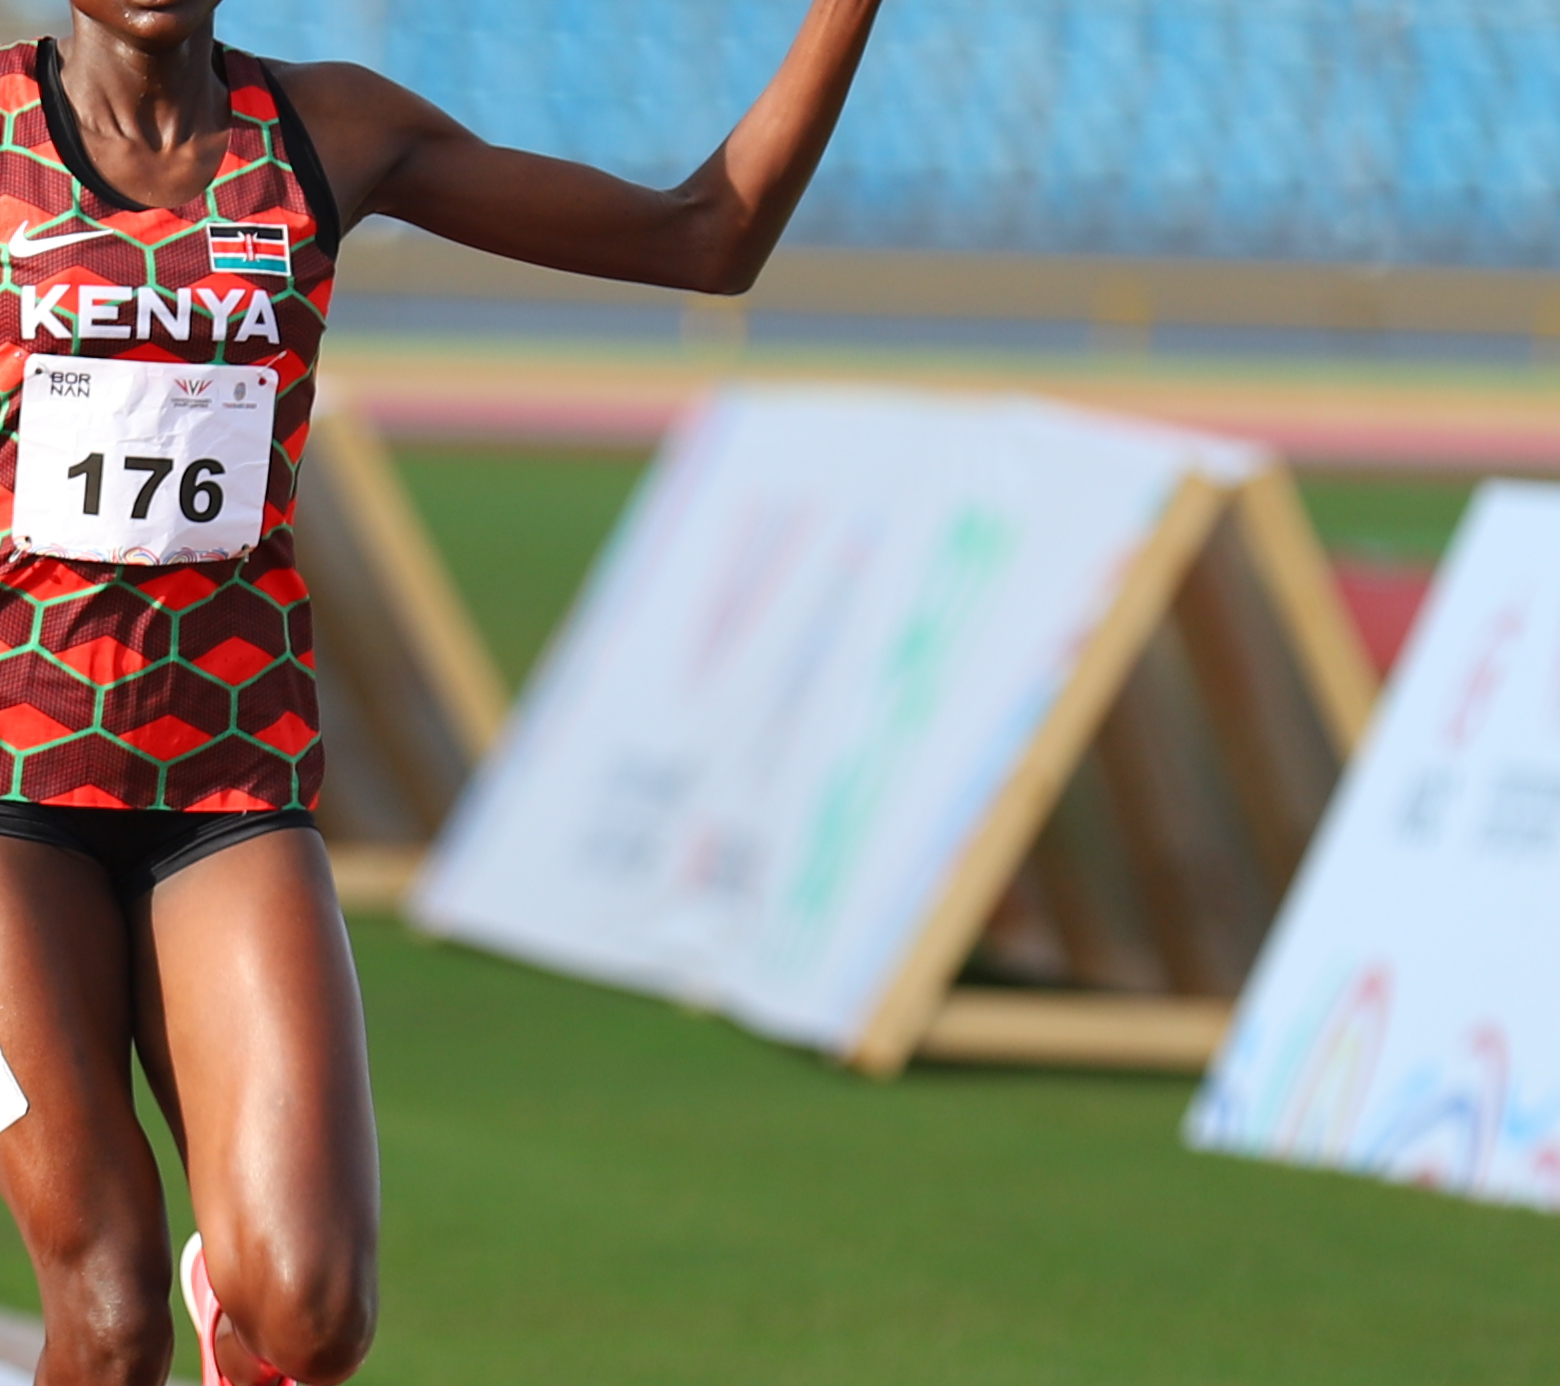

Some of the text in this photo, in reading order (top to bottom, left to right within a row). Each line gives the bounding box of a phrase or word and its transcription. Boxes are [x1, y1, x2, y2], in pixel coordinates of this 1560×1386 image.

[20, 284, 281, 344] KENYA
[49, 383, 91, 398] NAN
[50, 371, 91, 385] BOR
[67, 452, 226, 523] 176
